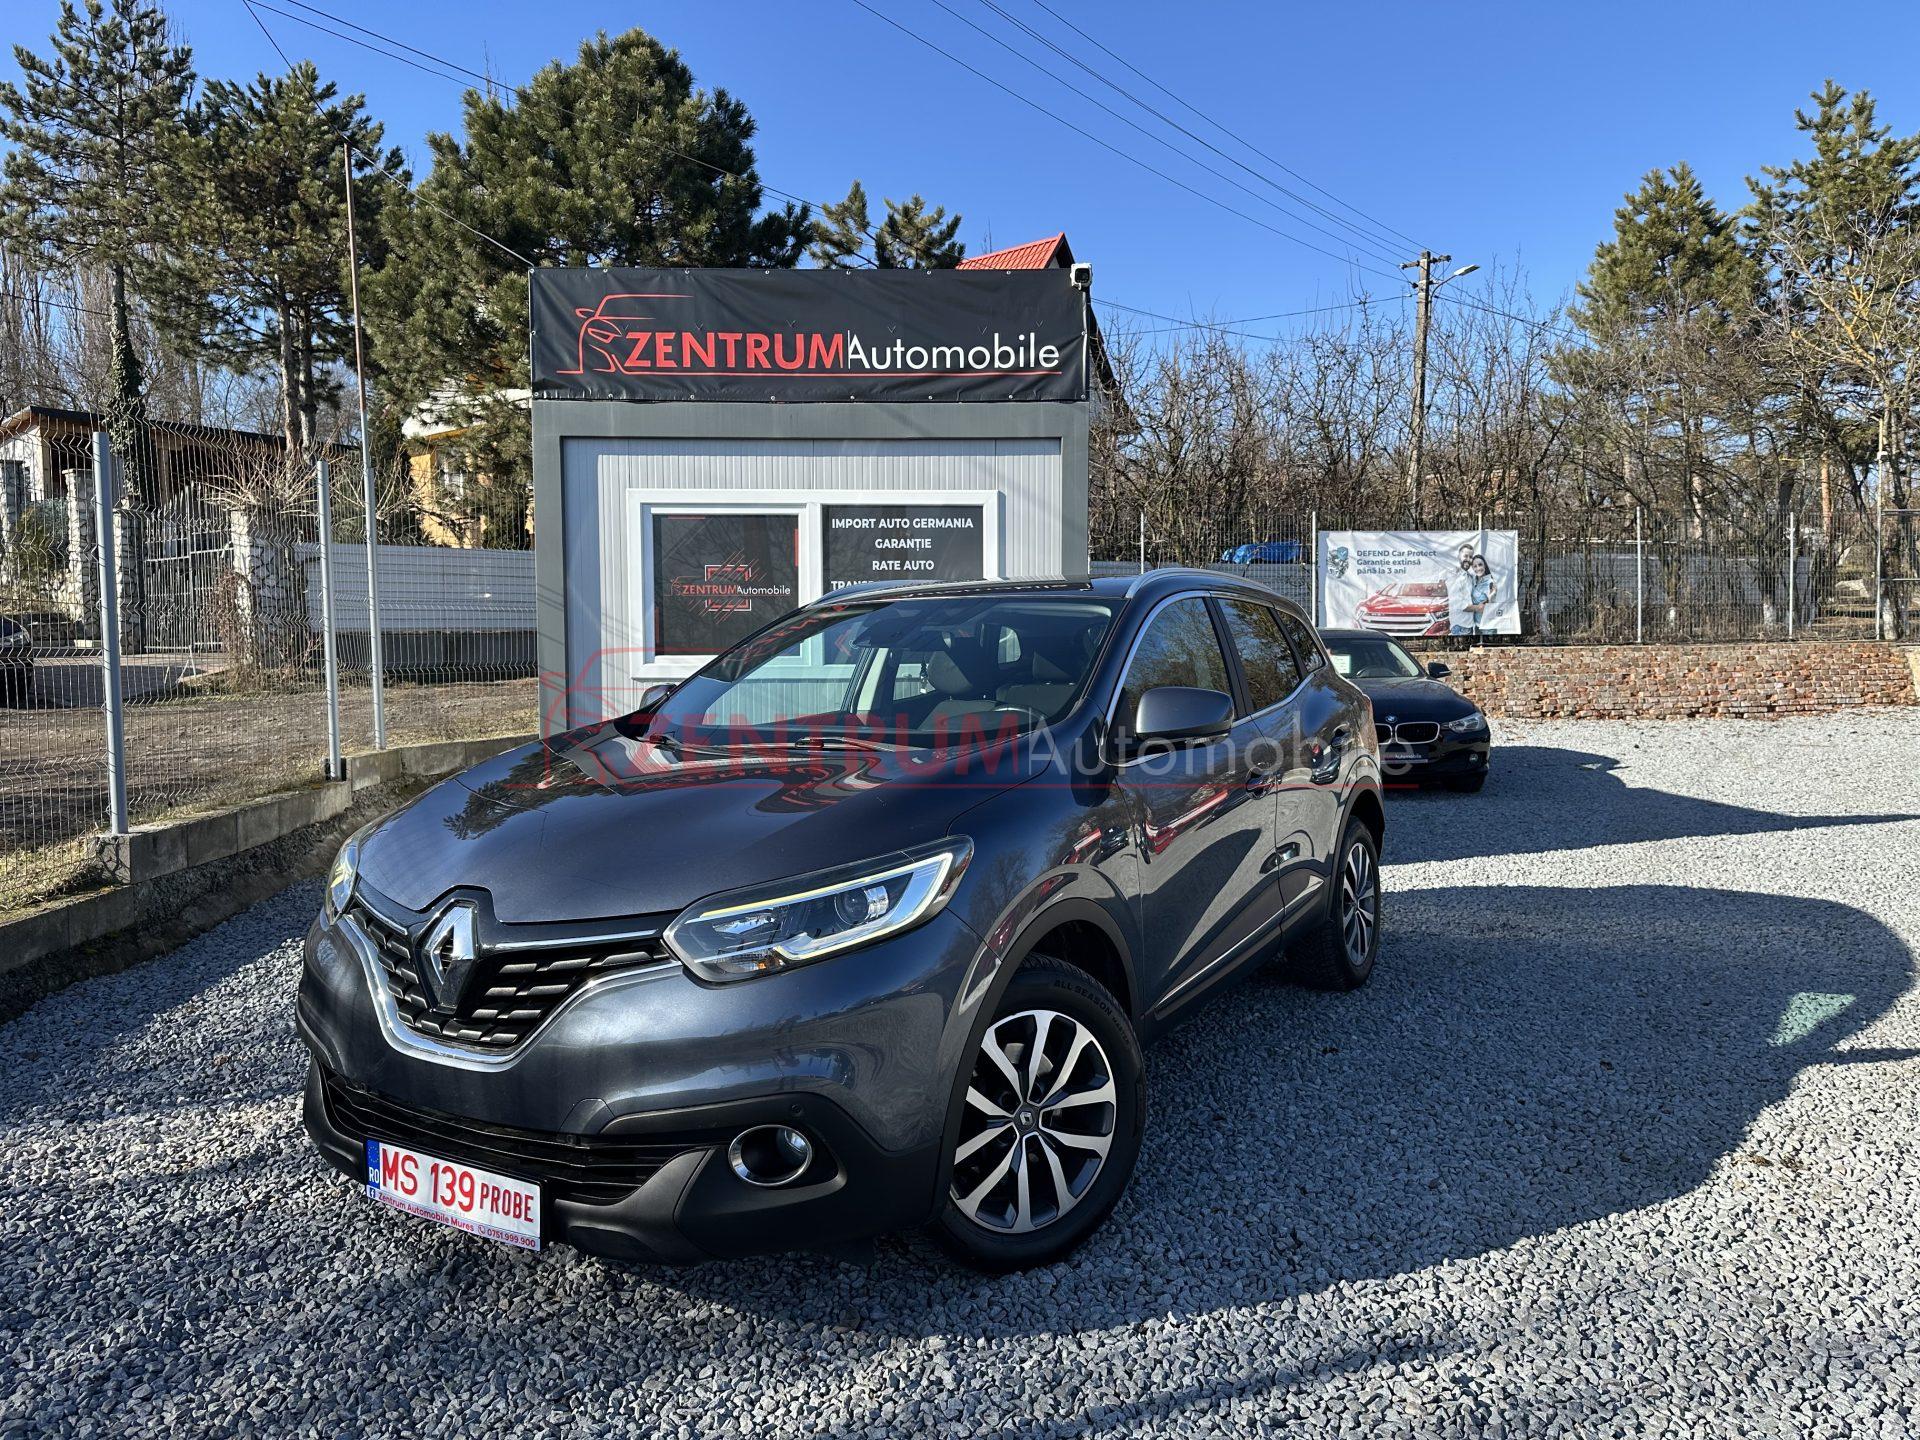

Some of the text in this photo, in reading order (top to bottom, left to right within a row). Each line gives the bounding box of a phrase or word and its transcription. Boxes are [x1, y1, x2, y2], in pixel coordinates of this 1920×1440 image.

[623, 330, 1061, 370] ZENTRUM Automobile
[831, 518, 974, 529] IMPORT AUTO GERMANIA
[874, 538, 932, 551] GARANȚIE
[872, 560, 935, 571] RATE AUTO
[682, 584, 791, 595] ZENTRUM Automobile
[368, 1167, 380, 1184] RO
[381, 1148, 534, 1223] MS 139 PROBE
[378, 1192, 406, 1209] Zentrum
[407, 1204, 449, 1223] Automobile
[451, 1217, 475, 1231] Mures
[487, 1228, 536, 1247] 0751.999.900
